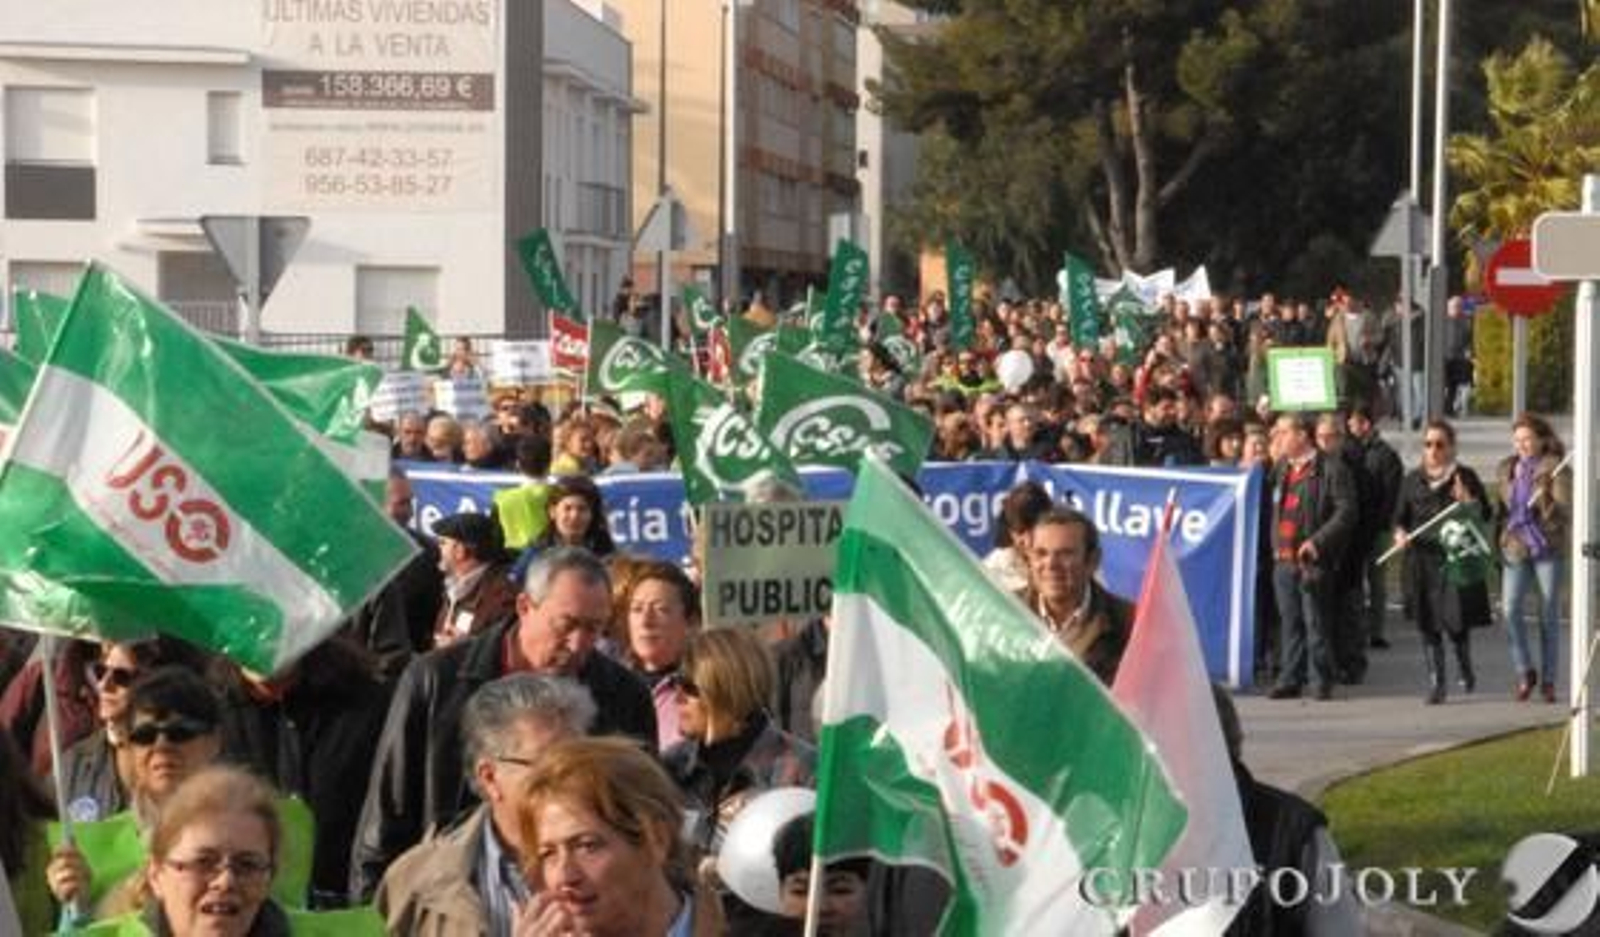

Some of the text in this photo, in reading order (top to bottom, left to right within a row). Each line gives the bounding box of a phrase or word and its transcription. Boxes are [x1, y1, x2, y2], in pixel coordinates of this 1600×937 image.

[370, 0, 490, 25] VIVIENDAS
[308, 32, 451, 58] A LA VENTA
[456, 75, 474, 98] €
